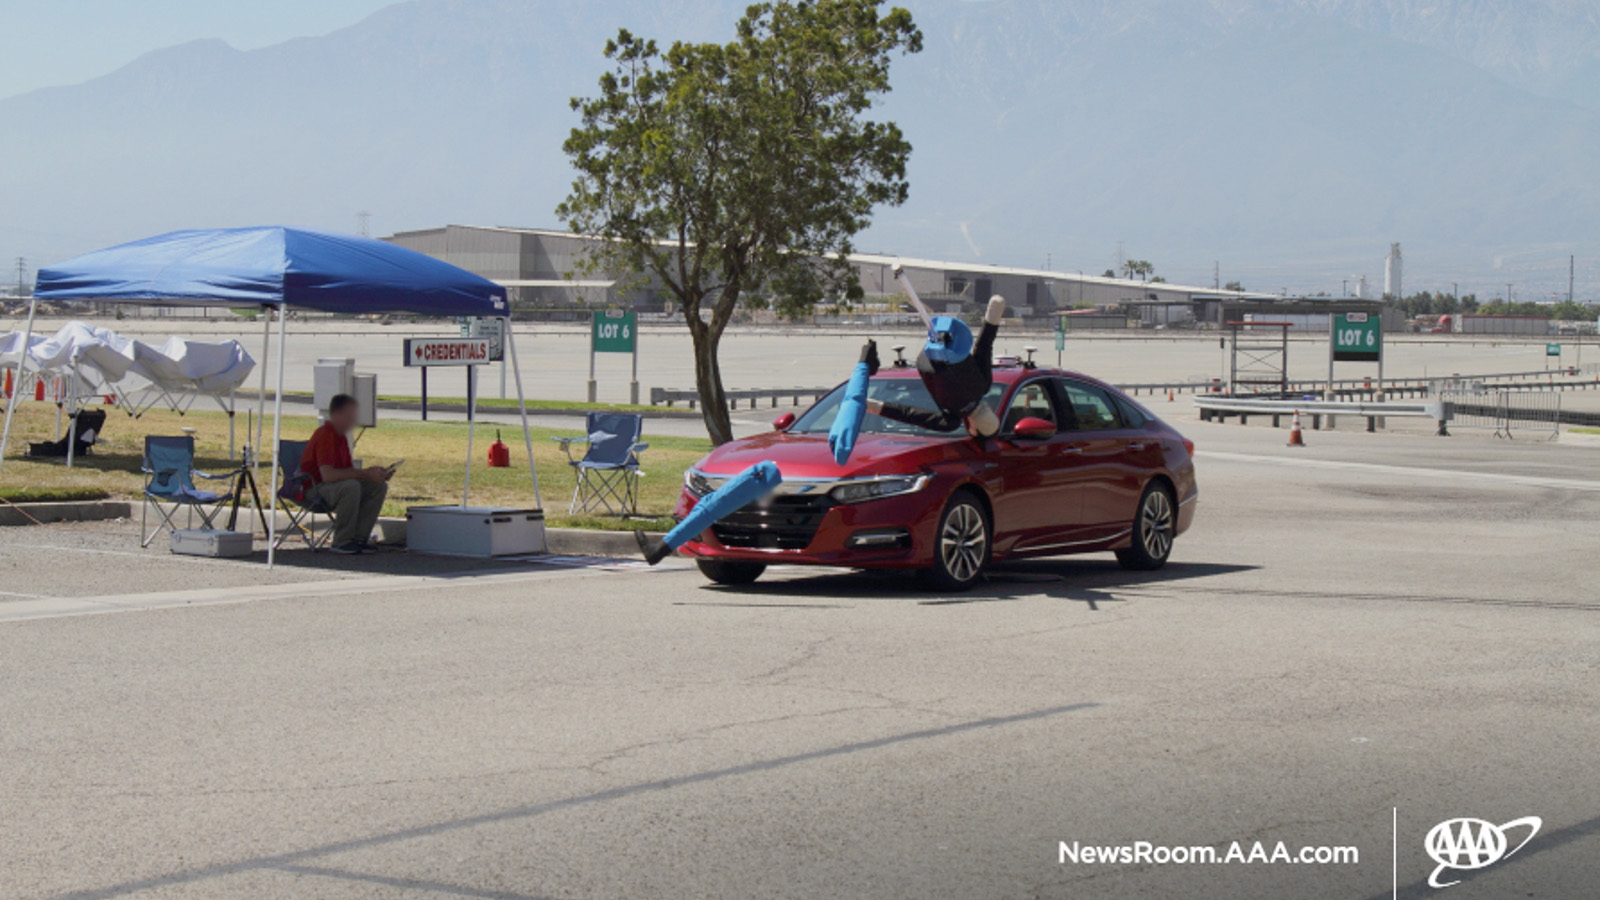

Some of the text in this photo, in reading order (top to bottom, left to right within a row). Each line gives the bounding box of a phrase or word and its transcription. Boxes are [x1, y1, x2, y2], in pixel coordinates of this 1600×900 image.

[598, 323, 630, 340] LOT 6
[1338, 329, 1375, 347] LOT 6
[424, 343, 487, 361] CREDENTIALS
